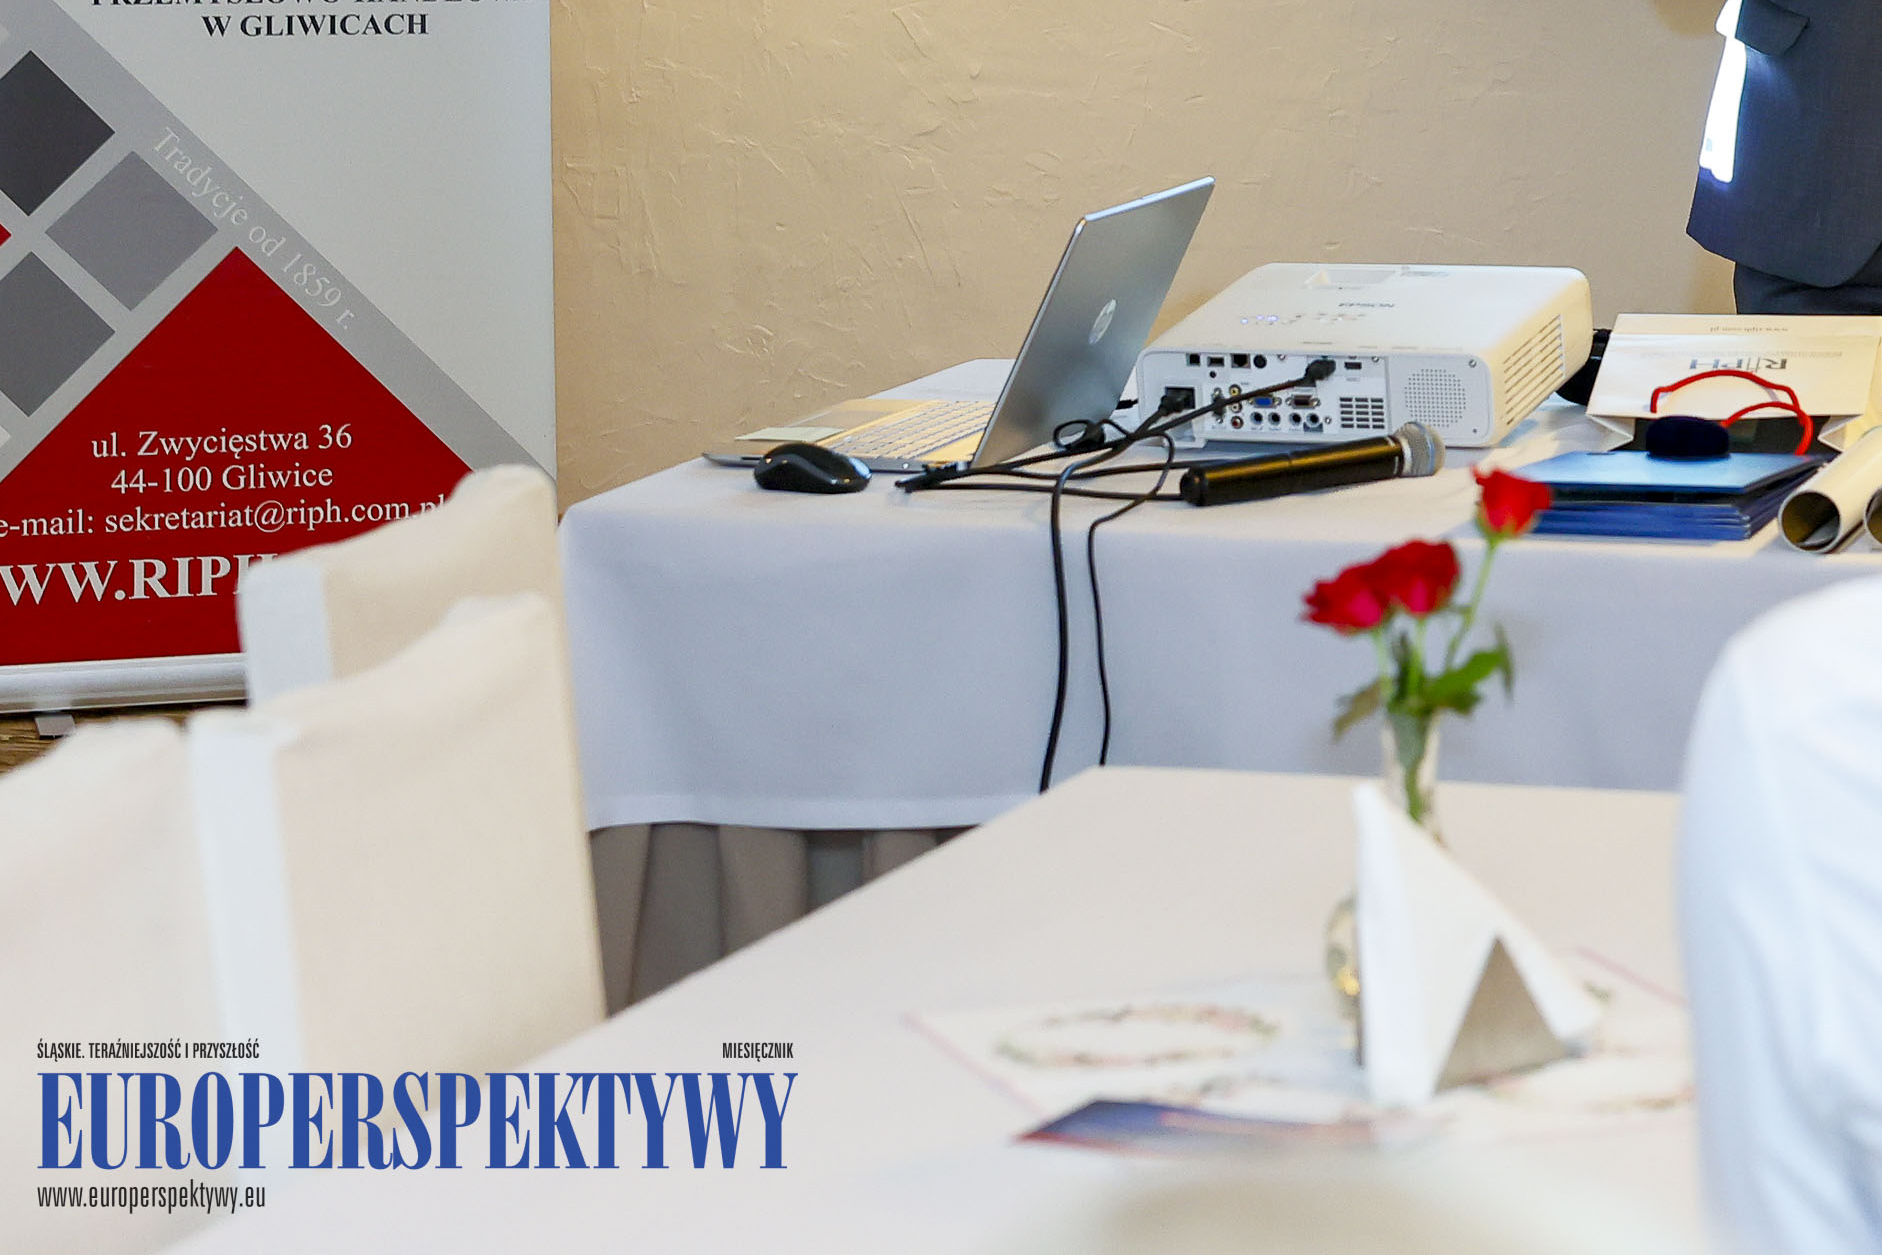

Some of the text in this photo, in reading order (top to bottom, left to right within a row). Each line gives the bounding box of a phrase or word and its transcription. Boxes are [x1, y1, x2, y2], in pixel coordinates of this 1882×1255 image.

[201, 12, 430, 38] W GLIWICACH
[153, 126, 355, 331] Tradycje od 1859 r.
[91, 423, 353, 462] ul. Zwycięstwa 36
[110, 461, 334, 494] 44-100 Gliwice
